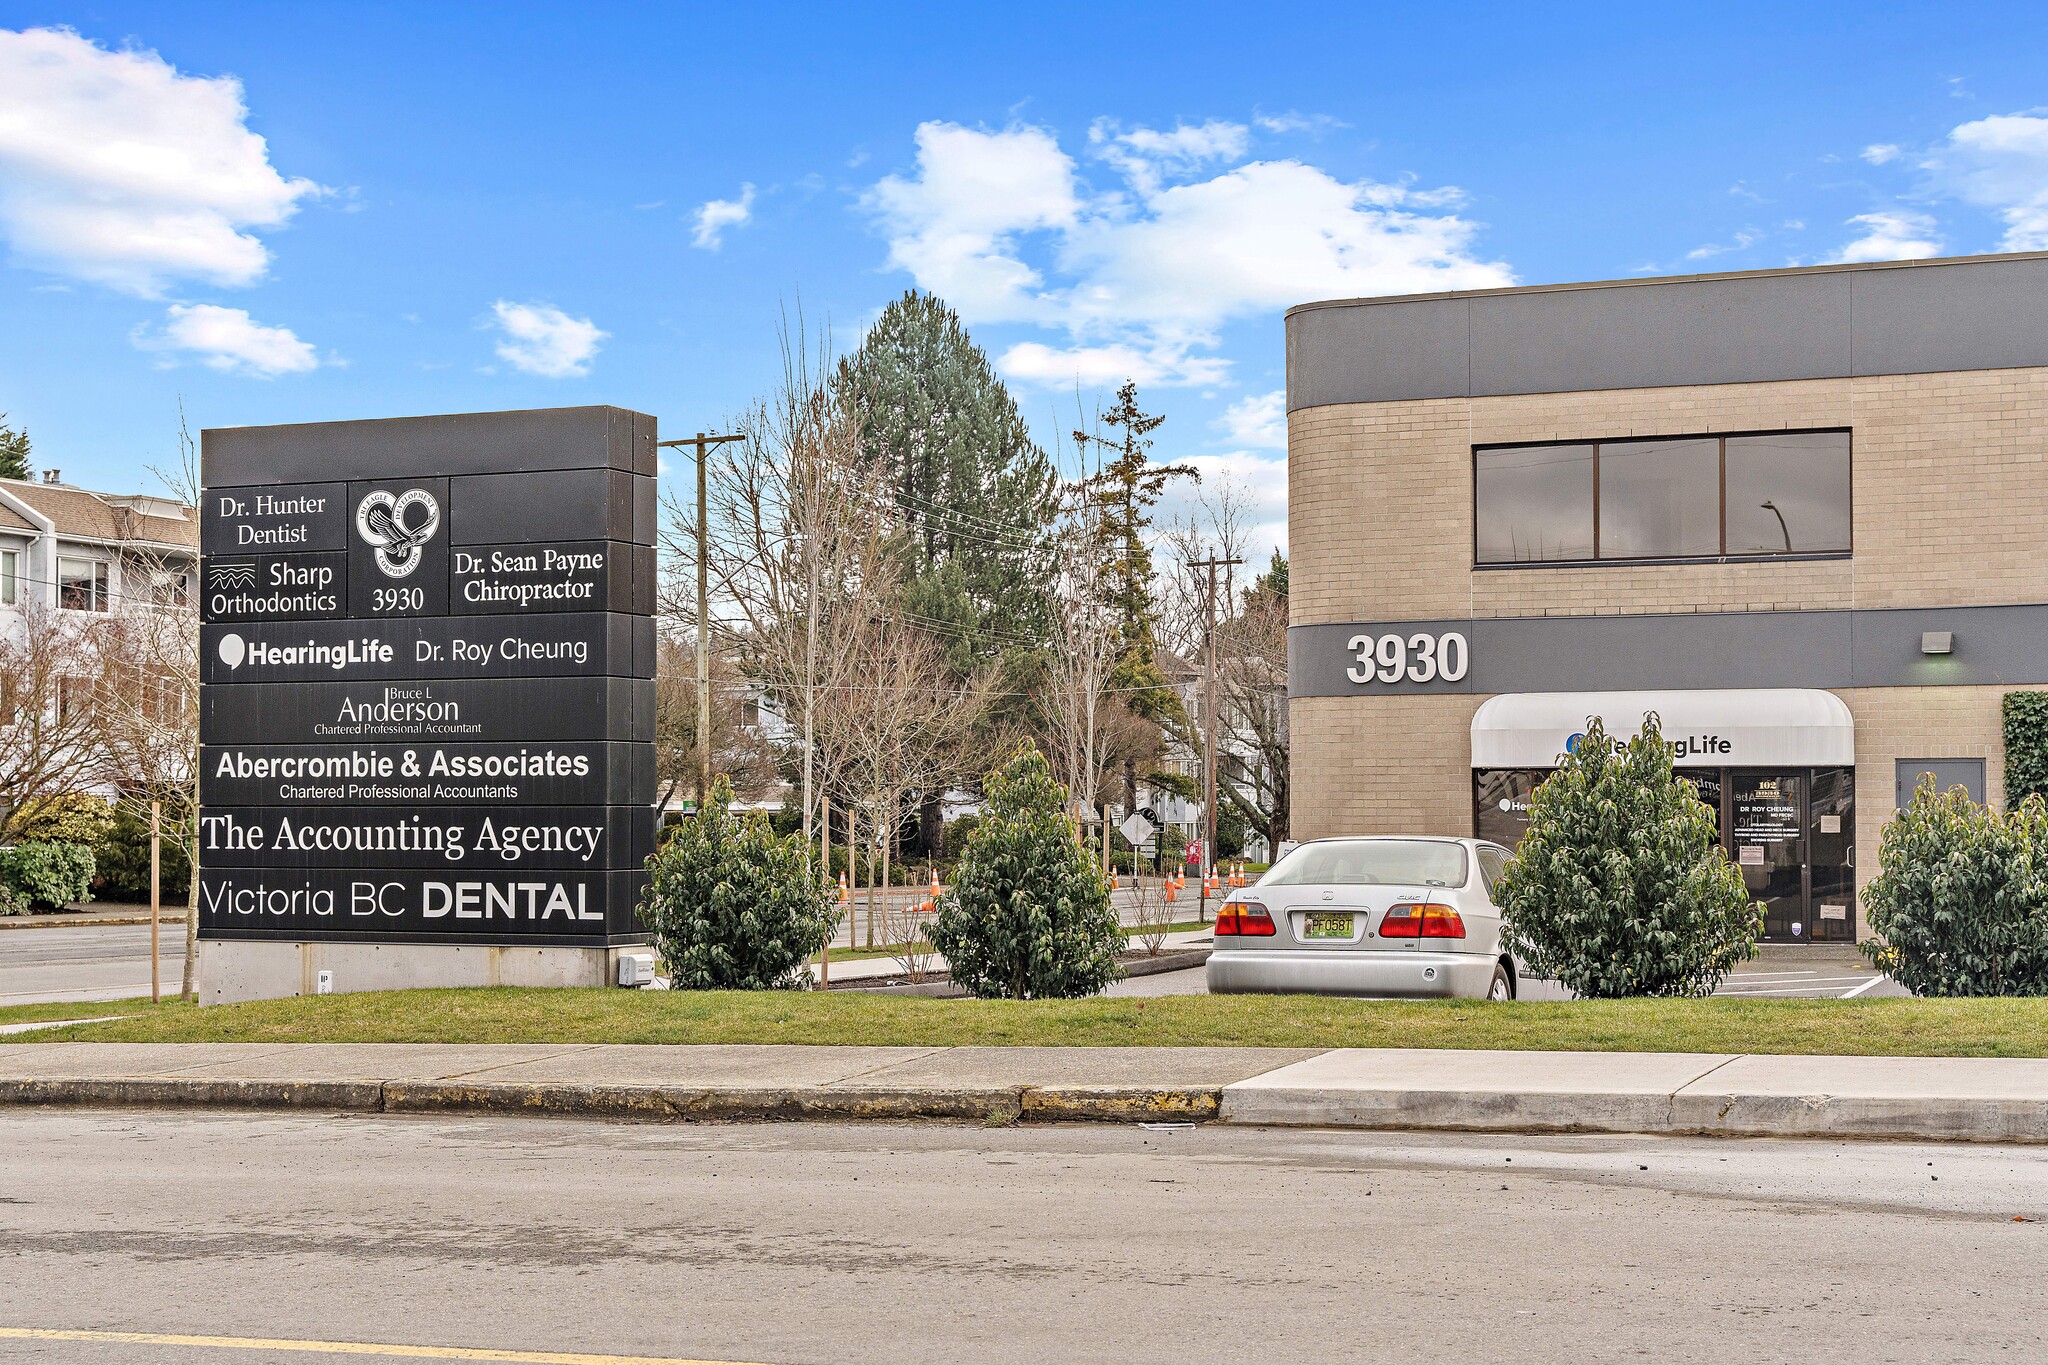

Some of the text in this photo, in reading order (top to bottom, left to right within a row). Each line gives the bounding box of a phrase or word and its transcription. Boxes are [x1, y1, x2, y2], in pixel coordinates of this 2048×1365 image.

[219, 495, 326, 518] Dr. Hunter
[359, 494, 388, 520] TRI-EAGLE
[395, 492, 436, 520] DEVELOPMENT
[237, 523, 308, 545] Dentist
[269, 561, 333, 591] Sharp
[379, 551, 420, 575] CORPORATION
[454, 549, 604, 577] Dr. Sean Payne
[211, 592, 337, 614] Orthodontics
[372, 587, 424, 611] 3930
[463, 578, 594, 607] Chiropractor
[248, 638, 394, 670] HearingLife
[416, 637, 588, 666] Dr. Roy Cheung
[1346, 632, 1469, 684] 3930
[337, 687, 459, 723] Anderson
[390, 687, 433, 700] Bruce L
[314, 722, 482, 735] Chartered Professional Accountant
[215, 748, 589, 779] Abercrombie & Associates
[279, 783, 518, 799] Chartered Professional Accountants
[1758, 781, 1777, 789] 102
[201, 814, 604, 862] The Accounting Agency
[201, 880, 604, 920] Victoria BC DENTAL
